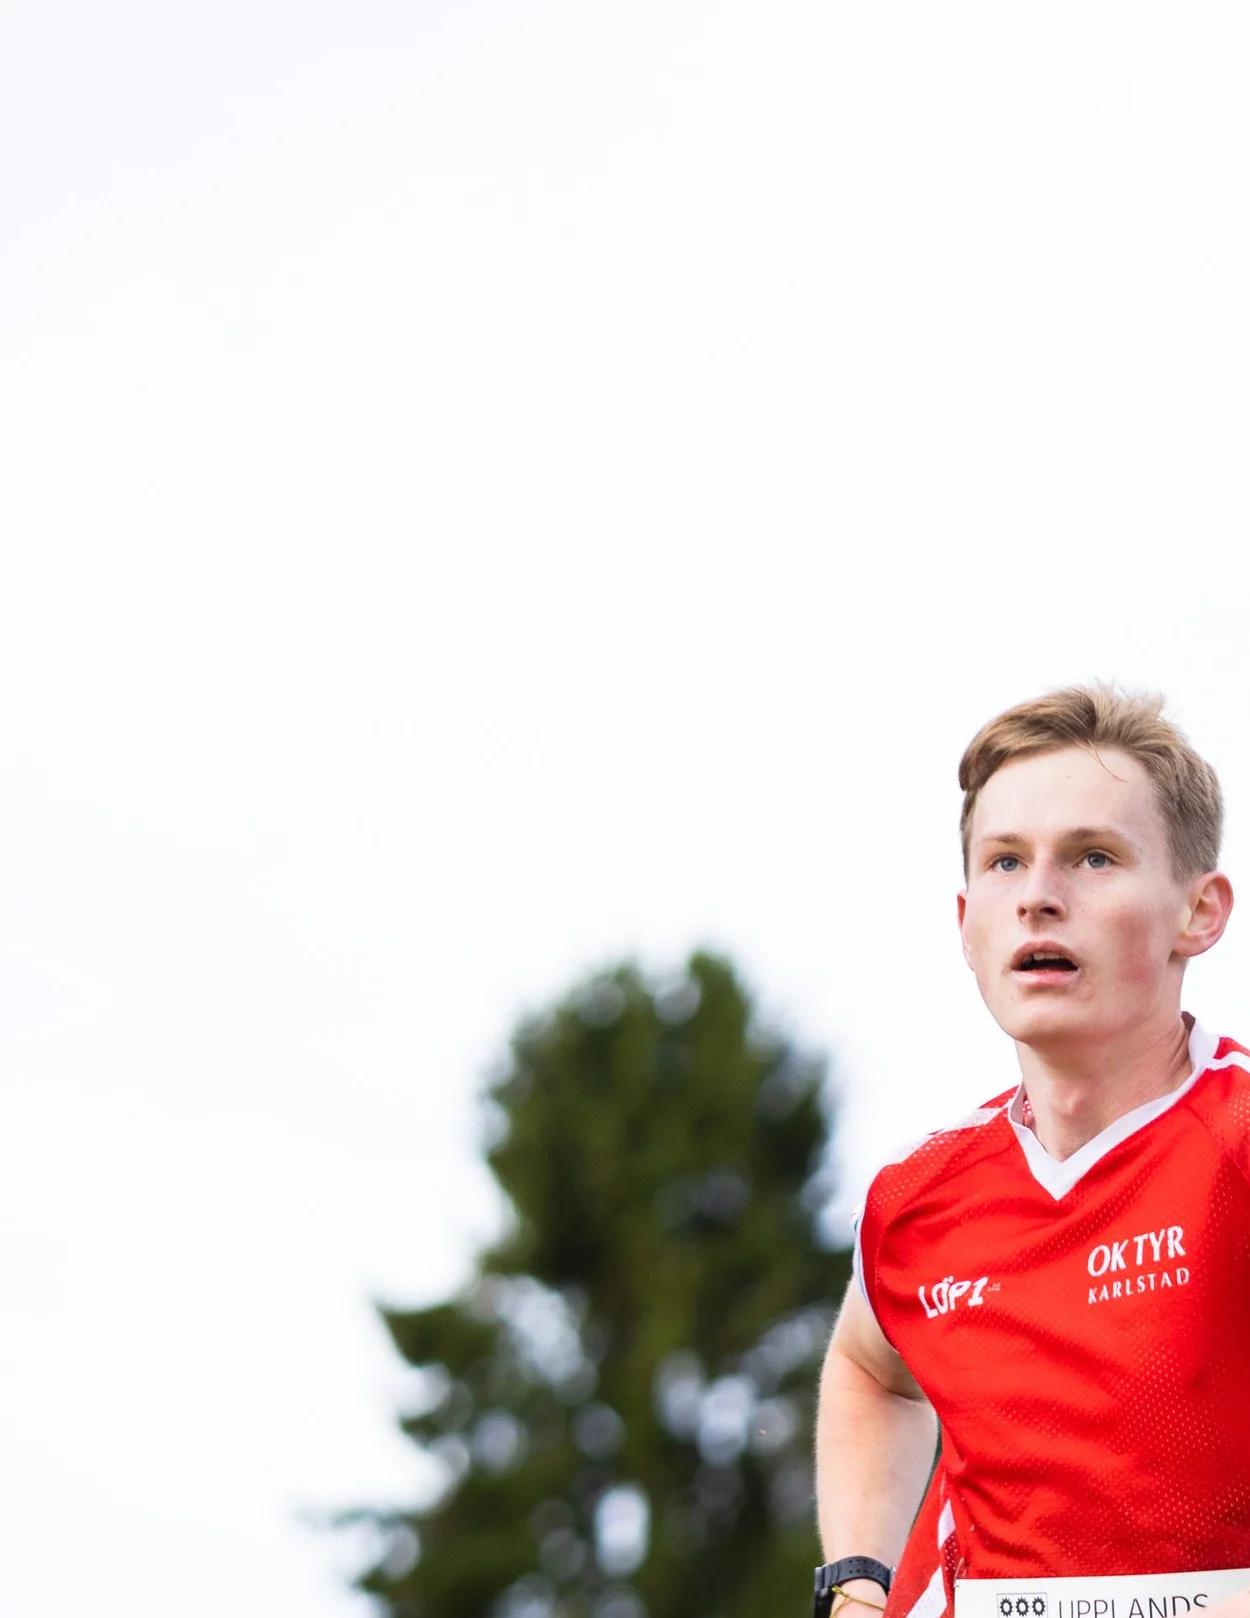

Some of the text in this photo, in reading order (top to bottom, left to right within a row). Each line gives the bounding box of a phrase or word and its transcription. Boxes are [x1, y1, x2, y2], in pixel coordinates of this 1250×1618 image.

[1087, 1225, 1186, 1277] OK TYR
[1087, 1267, 1190, 1304] KARLSTAD
